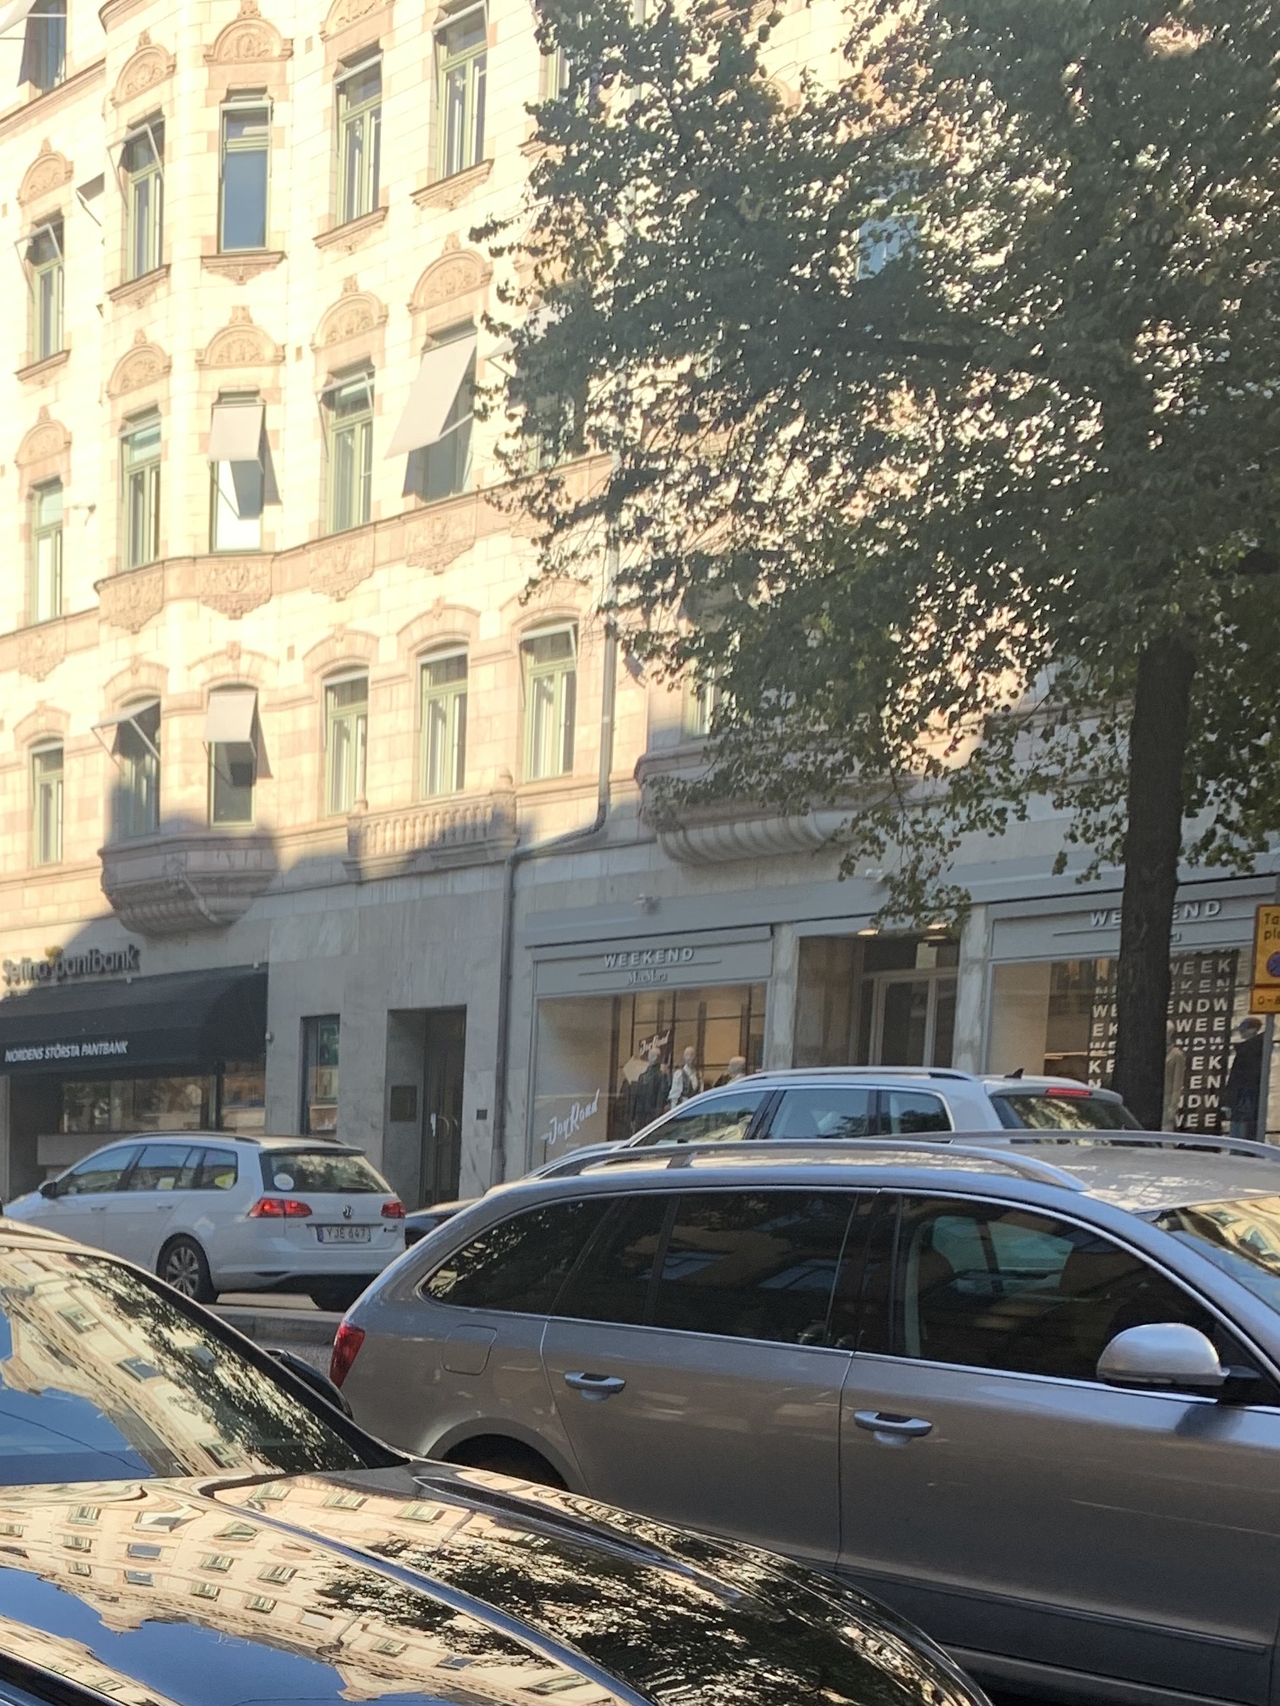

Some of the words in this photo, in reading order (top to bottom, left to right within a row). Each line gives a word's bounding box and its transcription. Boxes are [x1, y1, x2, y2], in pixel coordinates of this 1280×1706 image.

[604, 948, 695, 968] WEEKEND
[5, 1047, 44, 1063] NORDENS
[45, 1042, 80, 1059] STÖRSTA
[81, 1040, 129, 1056] PANTBANK
